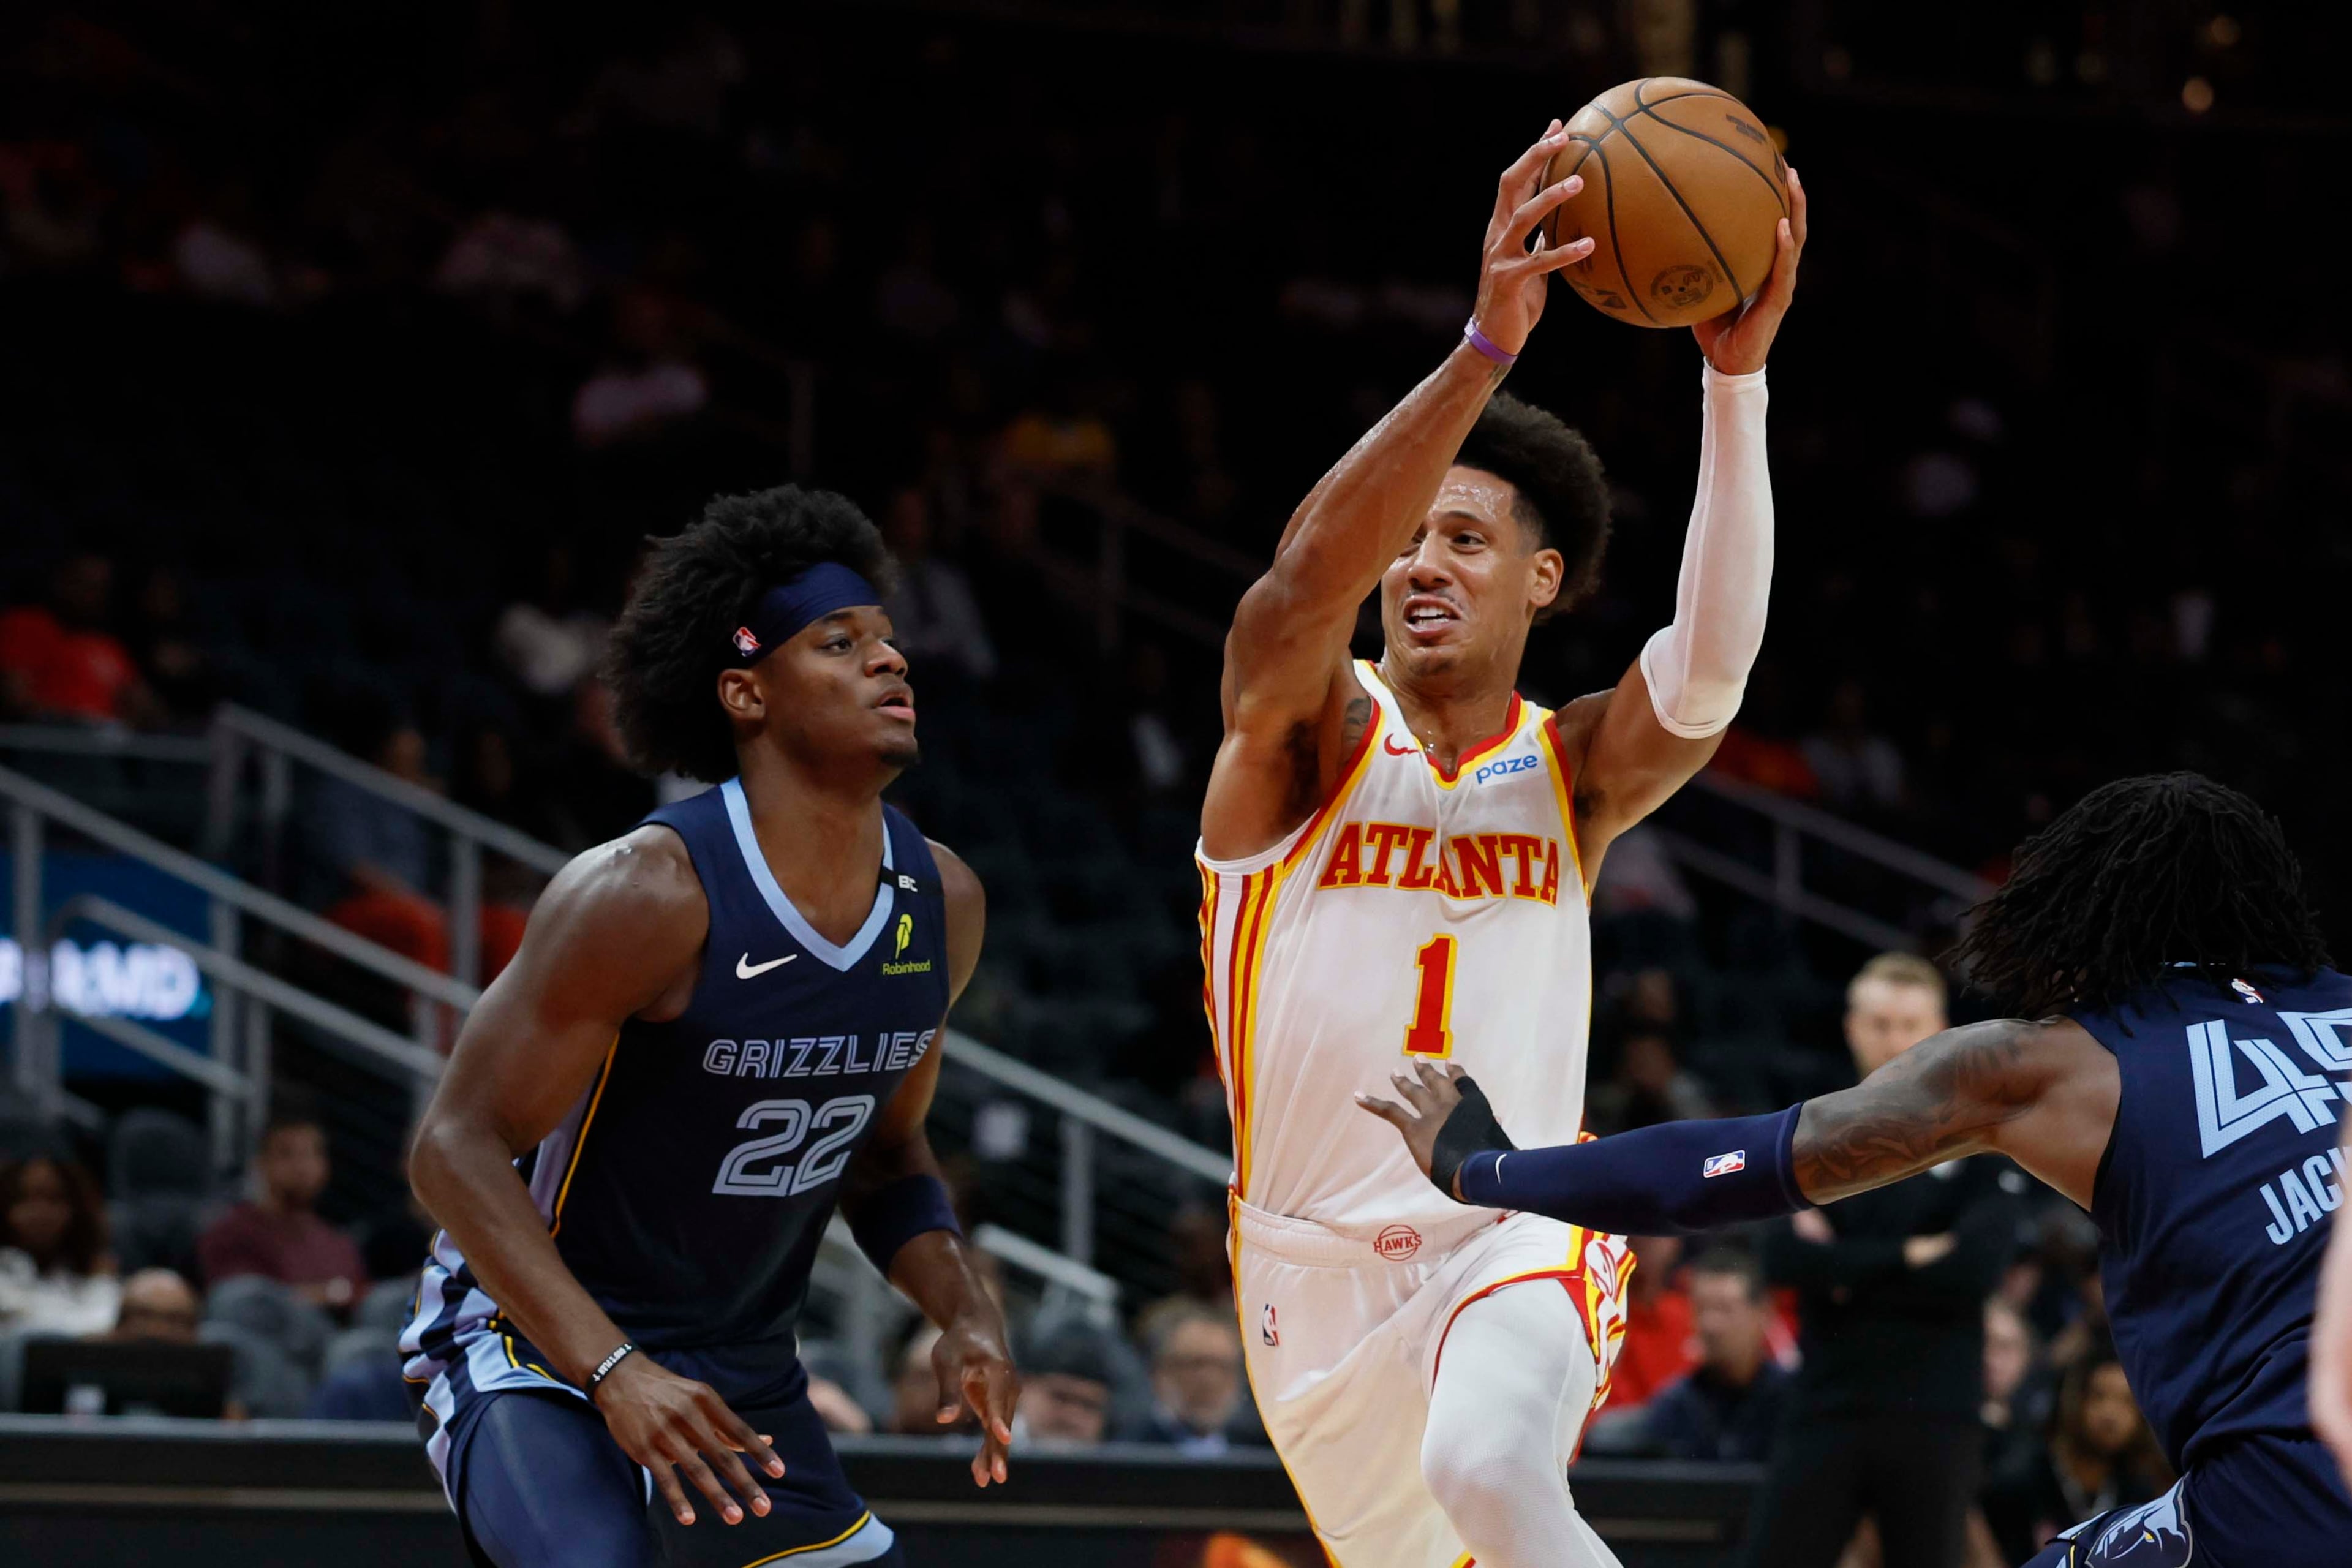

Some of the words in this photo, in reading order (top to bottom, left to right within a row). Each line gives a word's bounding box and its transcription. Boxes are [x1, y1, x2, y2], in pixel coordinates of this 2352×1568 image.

[1476, 755, 1538, 785] paze
[1316, 821, 1558, 909] ATLANTA
[882, 959, 932, 976] Robinhood
[1402, 933, 1457, 1060] 1
[702, 1028, 938, 1079] GRIZZLIES
[712, 1095, 876, 1197] 22
[1373, 1234, 1422, 1253] HAWKS
